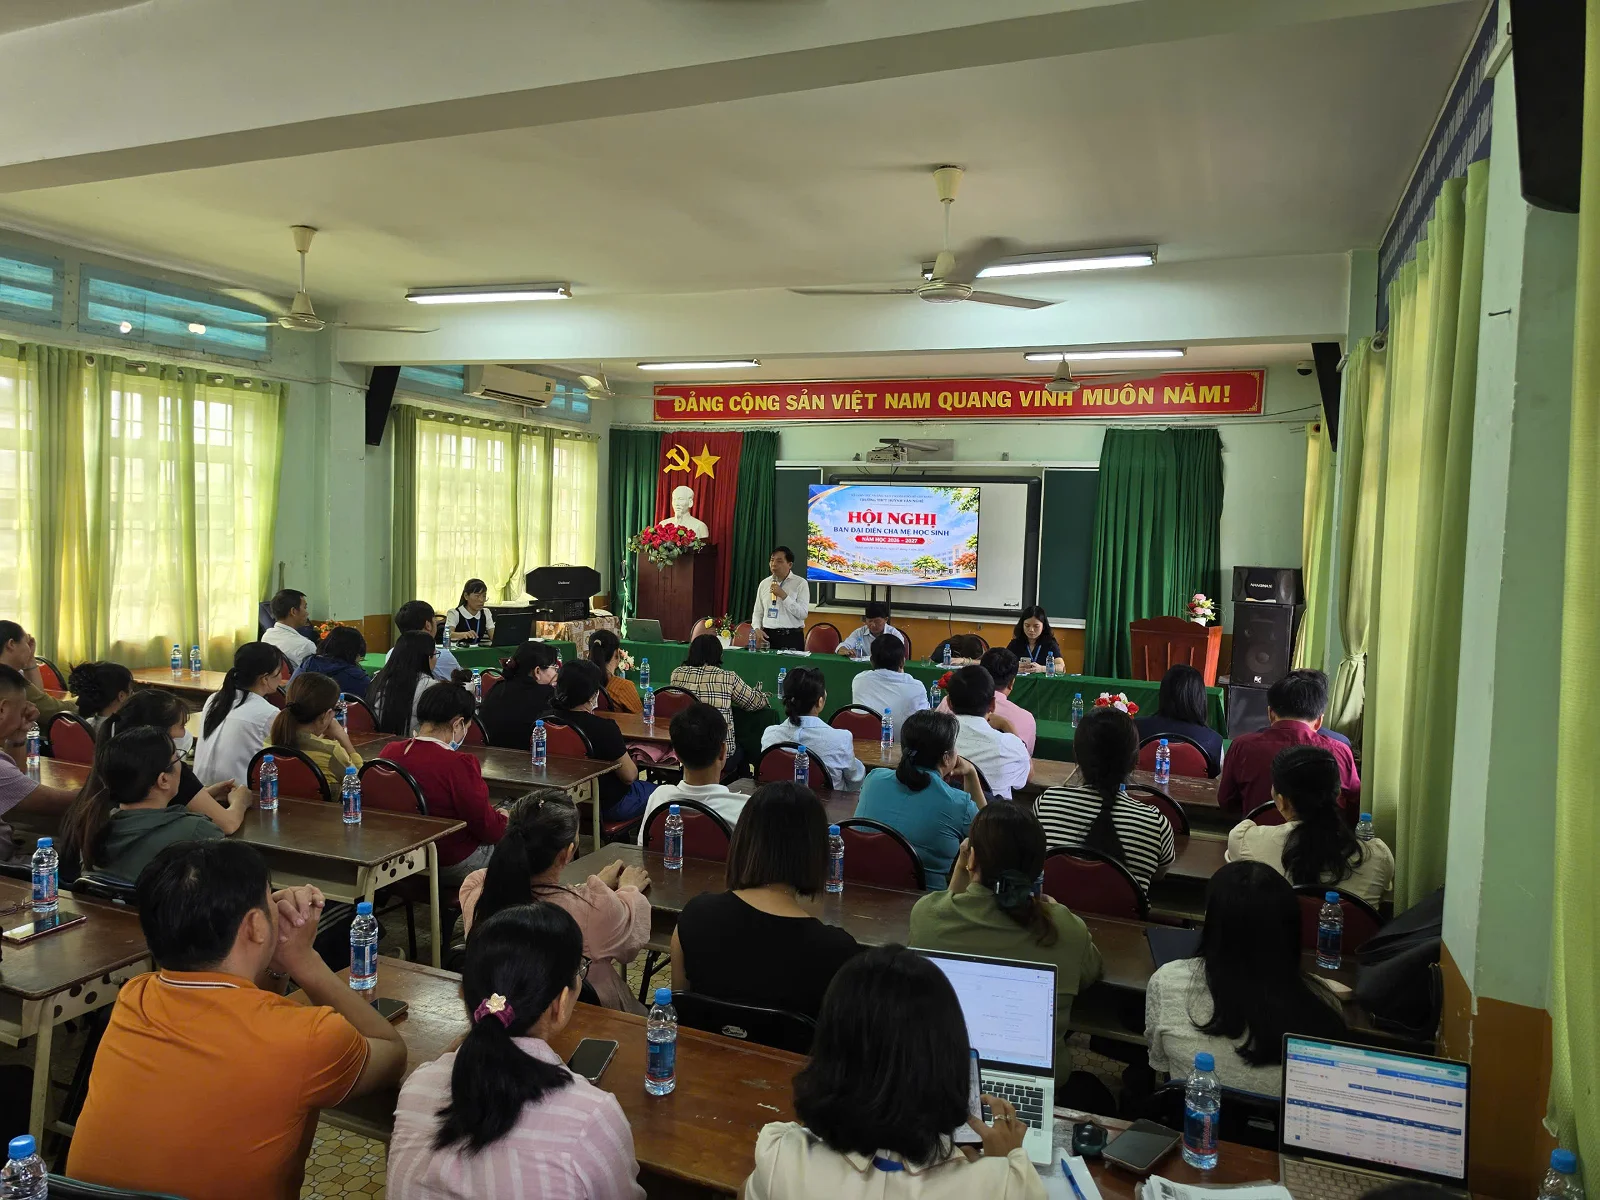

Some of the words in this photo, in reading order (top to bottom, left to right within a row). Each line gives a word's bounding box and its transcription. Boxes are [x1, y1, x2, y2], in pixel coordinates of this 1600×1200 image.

[674, 390, 724, 412] ĐẢNG
[729, 391, 780, 414] CỘNG
[785, 388, 825, 411] SẢN
[831, 389, 877, 412] VIỆT
[885, 392, 931, 409] NAM
[938, 389, 1012, 411] QUANG
[1019, 389, 1073, 407] VINH
[1082, 383, 1154, 406] MUÔN
[1163, 382, 1230, 404] NĂM!
[848, 508, 882, 526] HỘI
[887, 512, 937, 528] NGHỊ
[850, 526, 864, 535] ĐẠI
[900, 528, 912, 537] MẸ
[913, 529, 929, 537] HỌC
[930, 529, 949, 537] SINH
